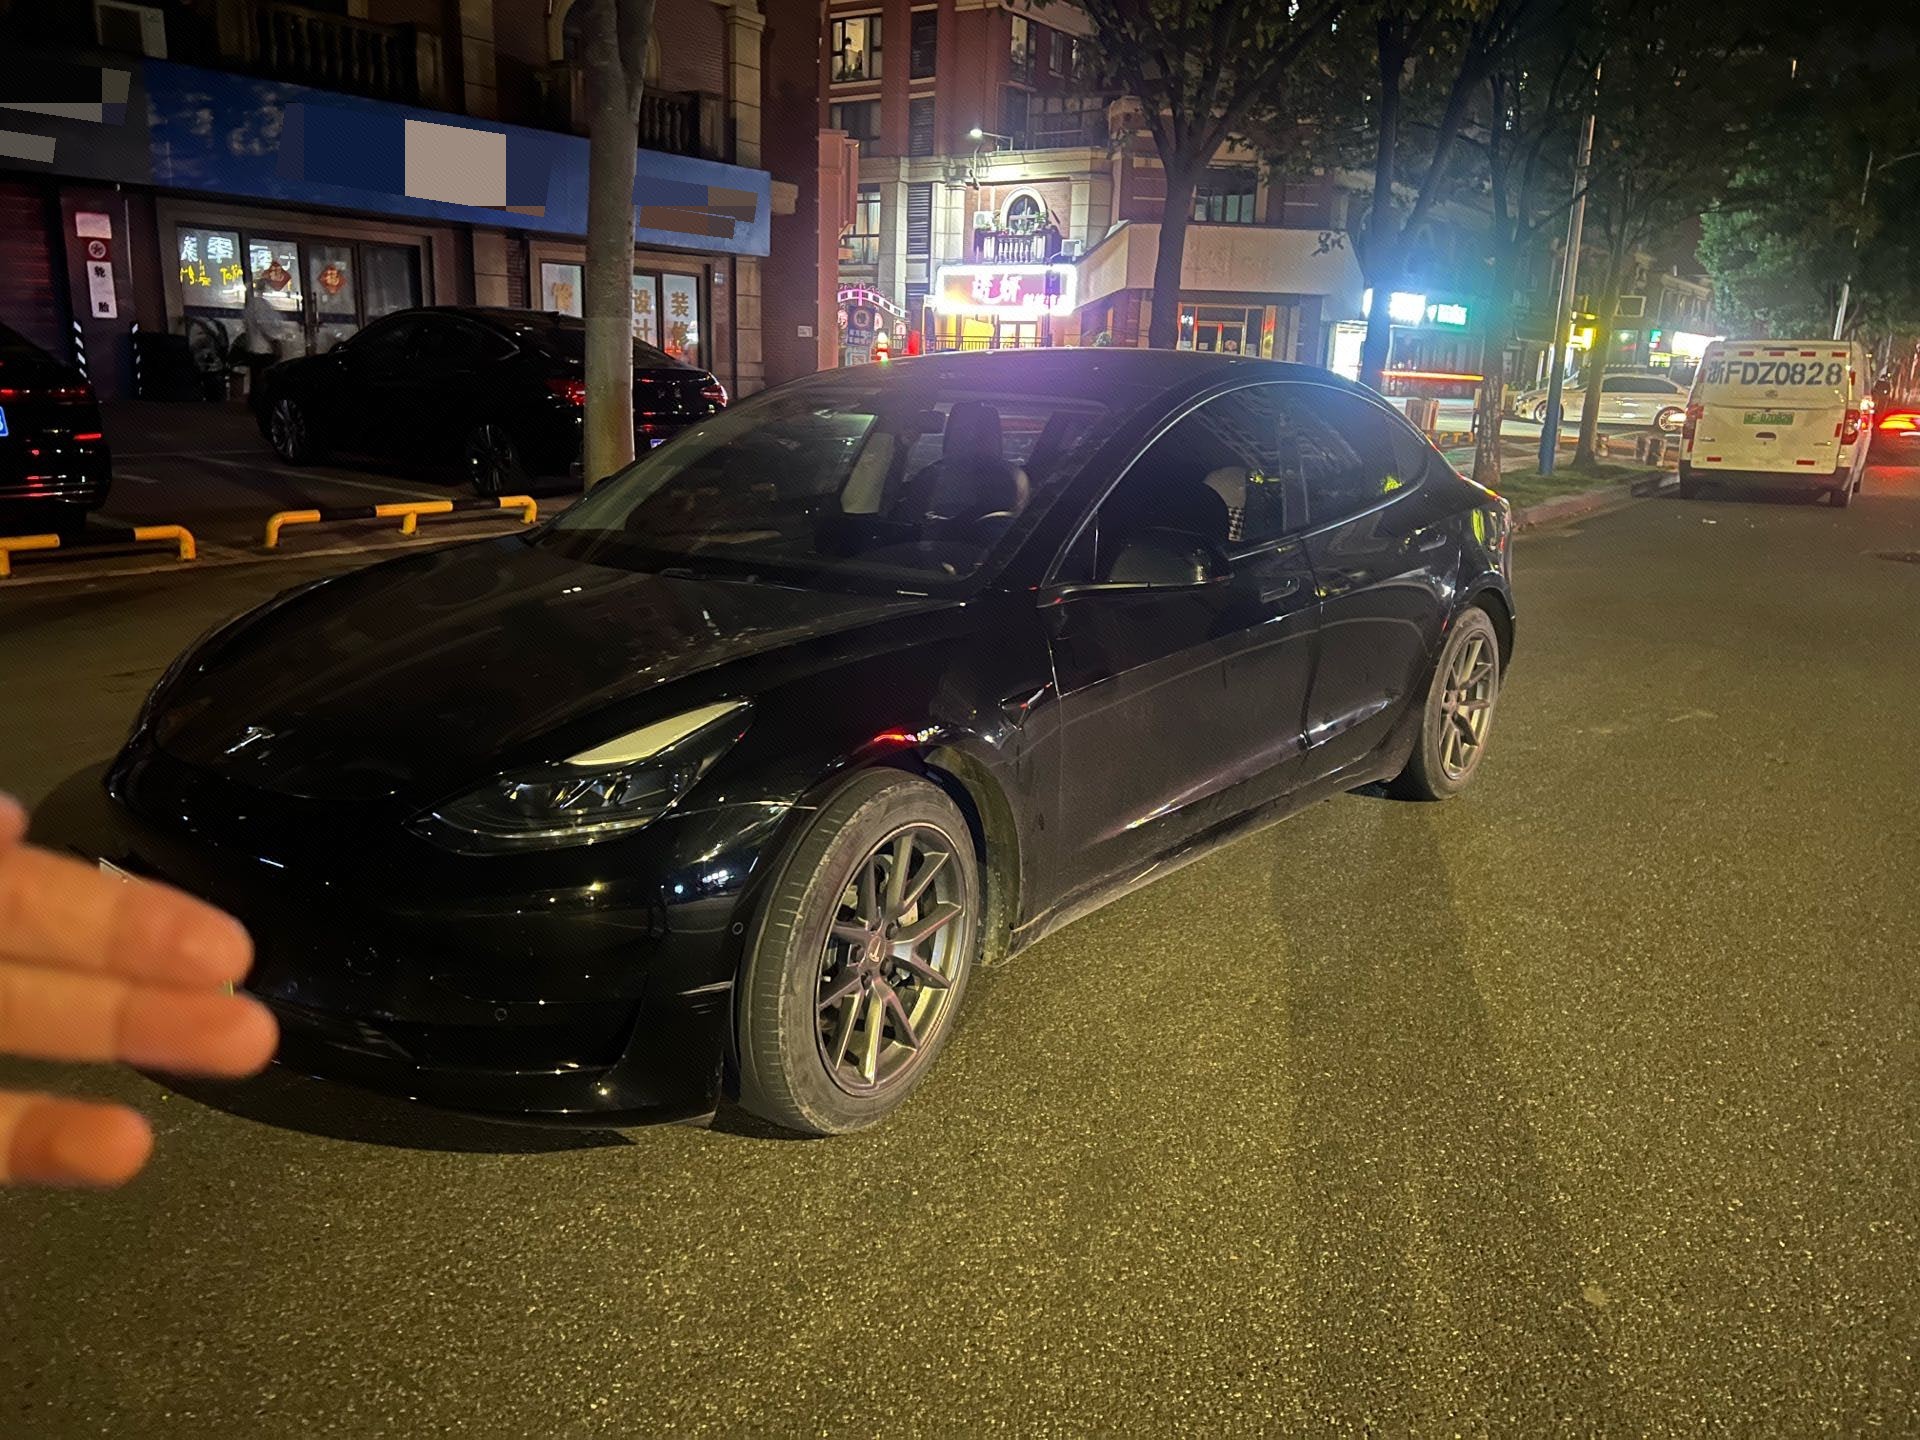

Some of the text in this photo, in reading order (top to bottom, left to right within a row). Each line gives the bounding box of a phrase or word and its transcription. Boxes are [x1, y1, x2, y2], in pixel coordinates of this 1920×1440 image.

[94, 265, 110, 313] 轮胎
[632, 289, 652, 342] 设计
[671, 291, 690, 348] 装修
[1707, 360, 1843, 386] 浙FDZ0828
